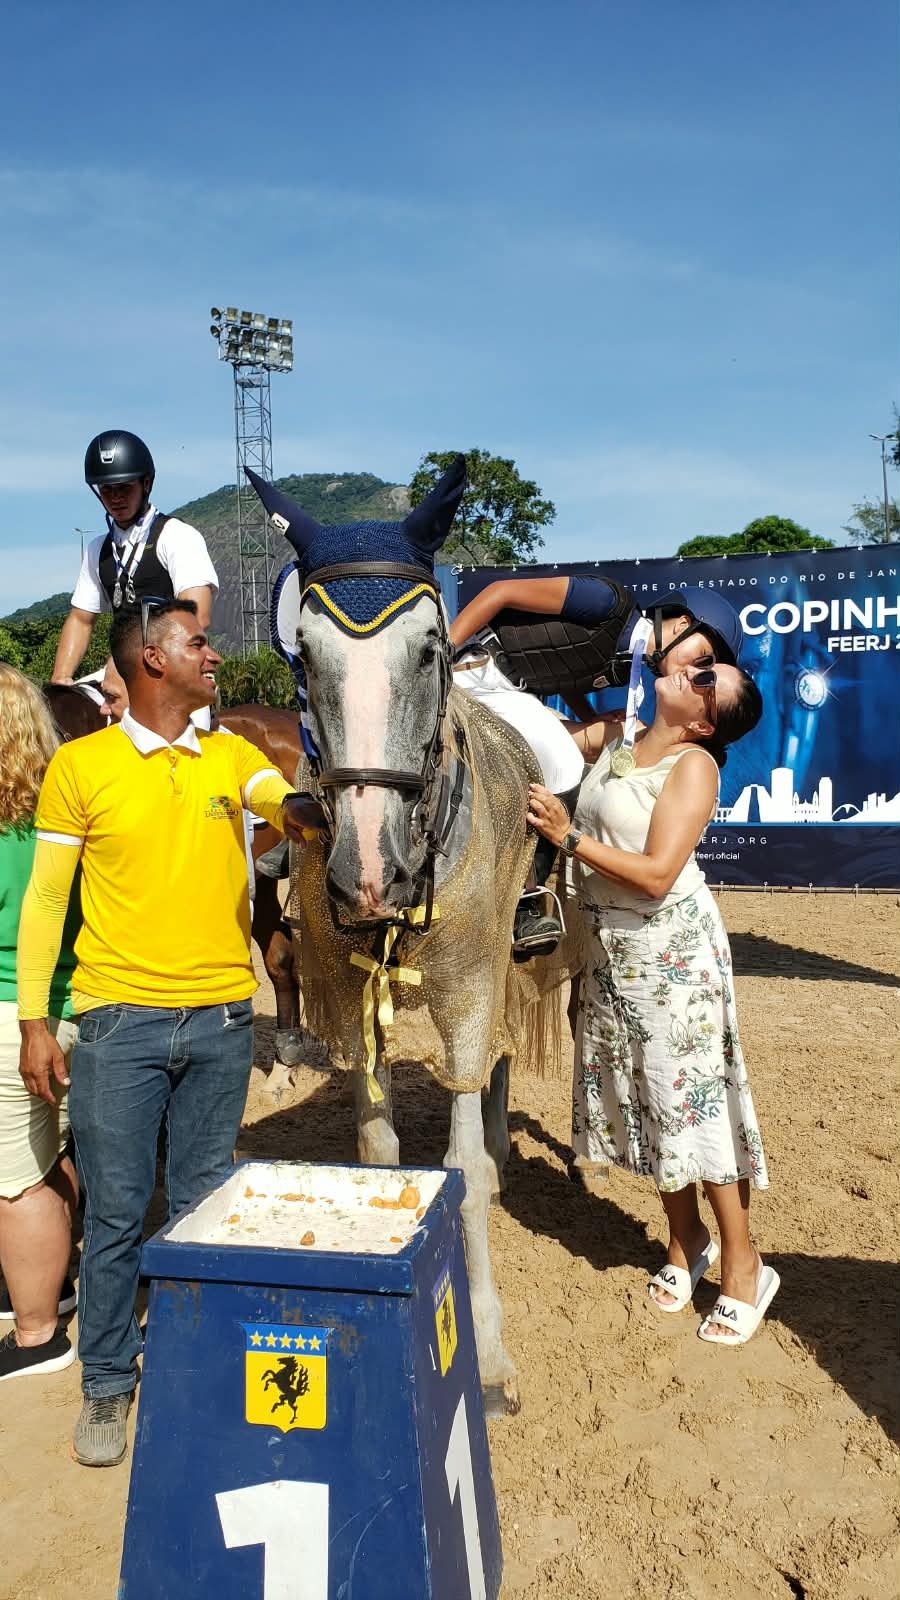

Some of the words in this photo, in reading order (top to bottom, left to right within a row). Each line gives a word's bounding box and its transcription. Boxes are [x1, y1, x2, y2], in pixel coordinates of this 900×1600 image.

[699, 577, 758, 589] ESTADO
[769, 575, 789, 585] DO
[800, 573, 826, 582] RIO
[838, 571, 856, 580] DE
[868, 568, 897, 578] JAN
[738, 596, 900, 636] COPINH
[827, 634, 891, 653] FEERJ
[713, 1303, 738, 1322] FILA
[215, 1479, 330, 1600] 1
